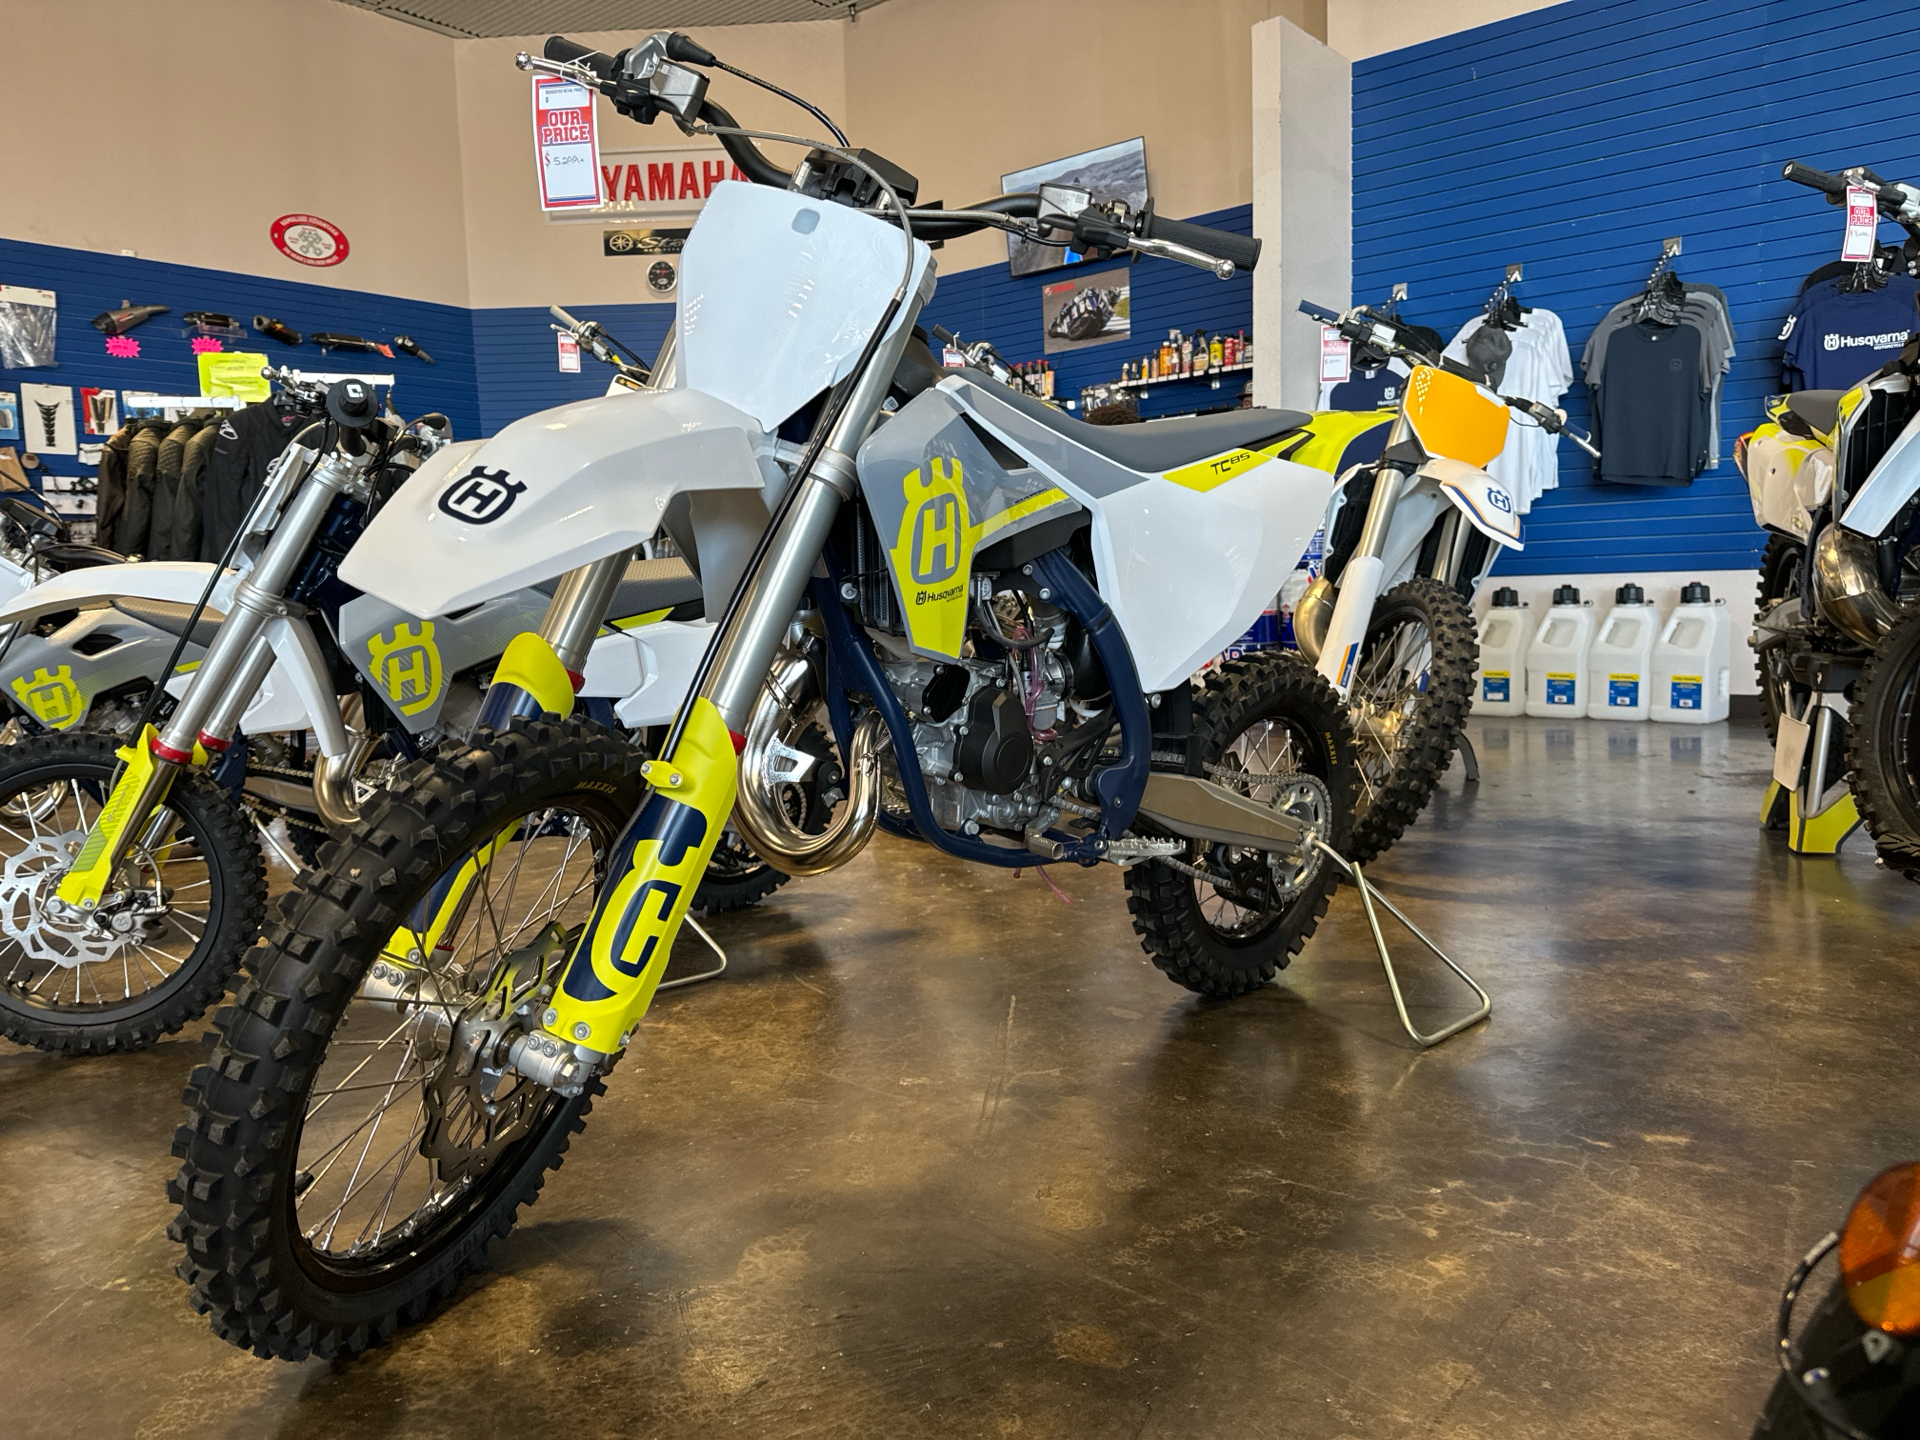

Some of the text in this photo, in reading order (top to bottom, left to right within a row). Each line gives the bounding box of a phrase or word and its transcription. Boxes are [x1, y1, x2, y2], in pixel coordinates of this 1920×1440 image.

[549, 110, 580, 127] OUR
[543, 126, 588, 143] PRICE
[1854, 207, 1870, 216] OUR
[1851, 215, 1873, 226] PRICE
[1841, 330, 1908, 348] Husqvarna
[927, 584, 964, 602] Husqvarna
[1324, 731, 1338, 765] MAXXIS
[573, 780, 618, 794] MAXXIS
